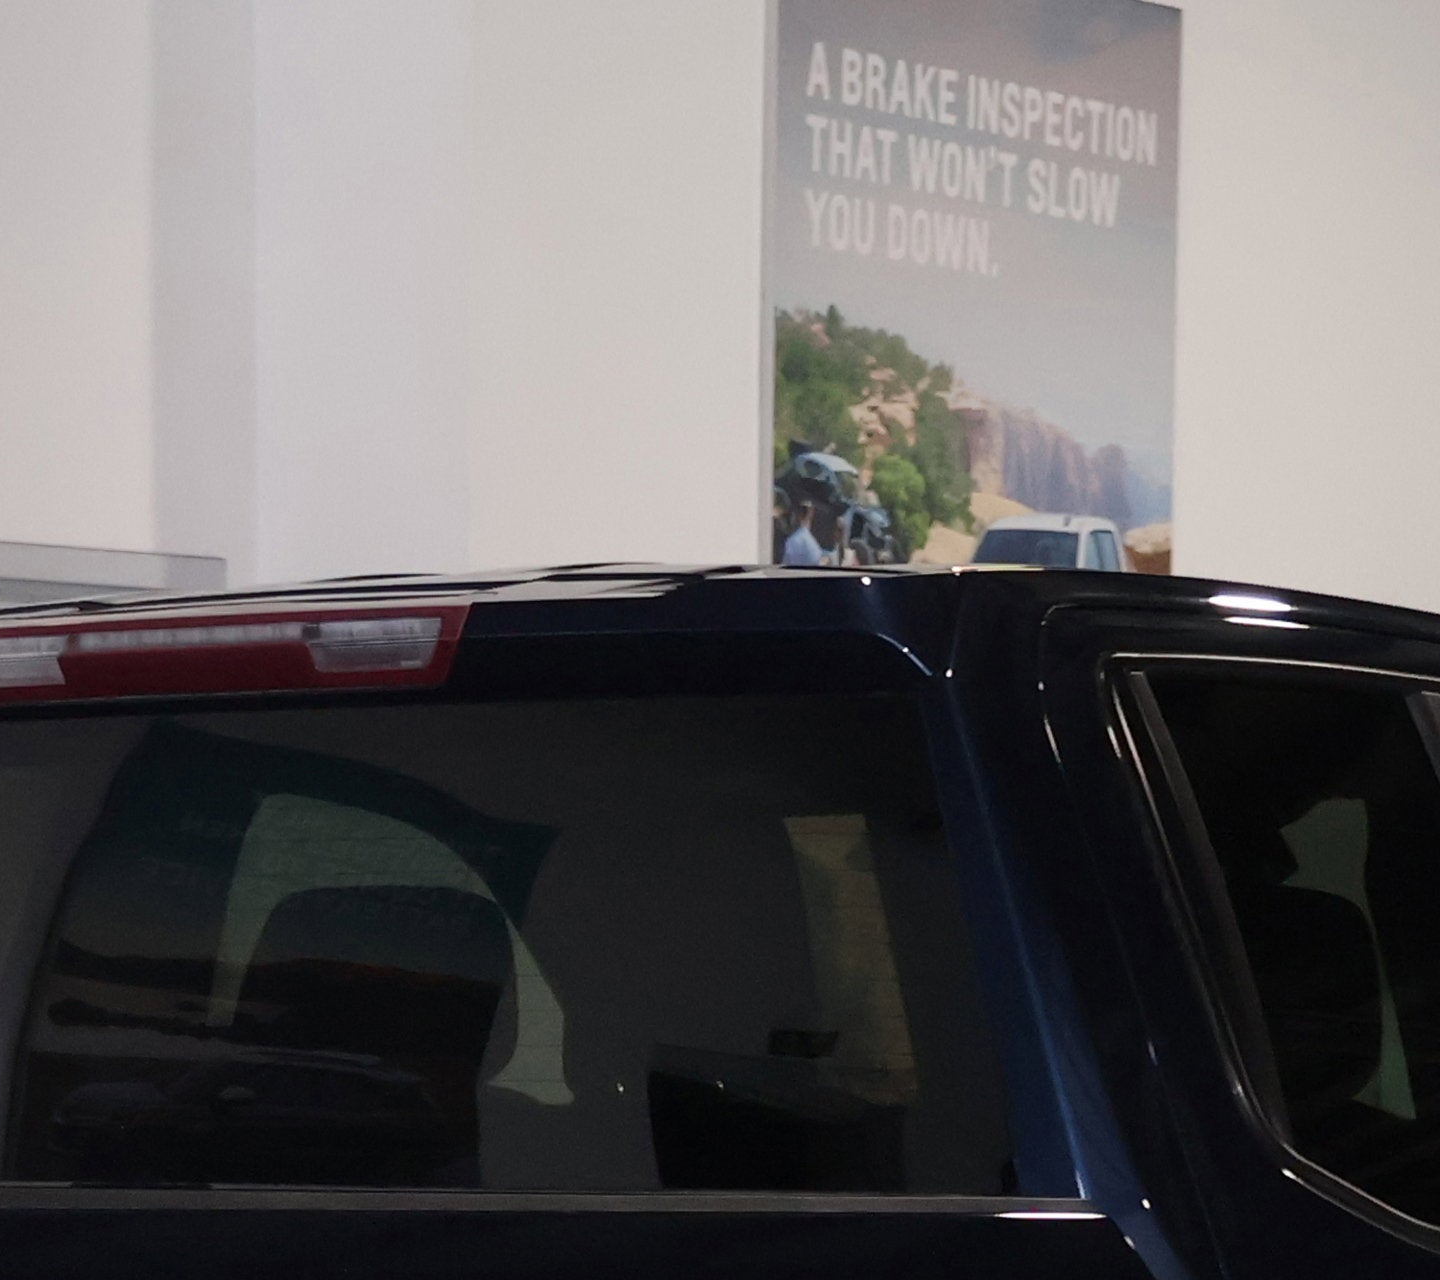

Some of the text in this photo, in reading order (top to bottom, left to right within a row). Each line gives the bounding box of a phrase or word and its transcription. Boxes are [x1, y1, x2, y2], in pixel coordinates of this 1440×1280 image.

[807, 42, 1158, 167] A BRAKE INSPECTION
[805, 116, 1120, 228] THAT WON'T SLOW
[804, 190, 1000, 278] YOU DOWN.
